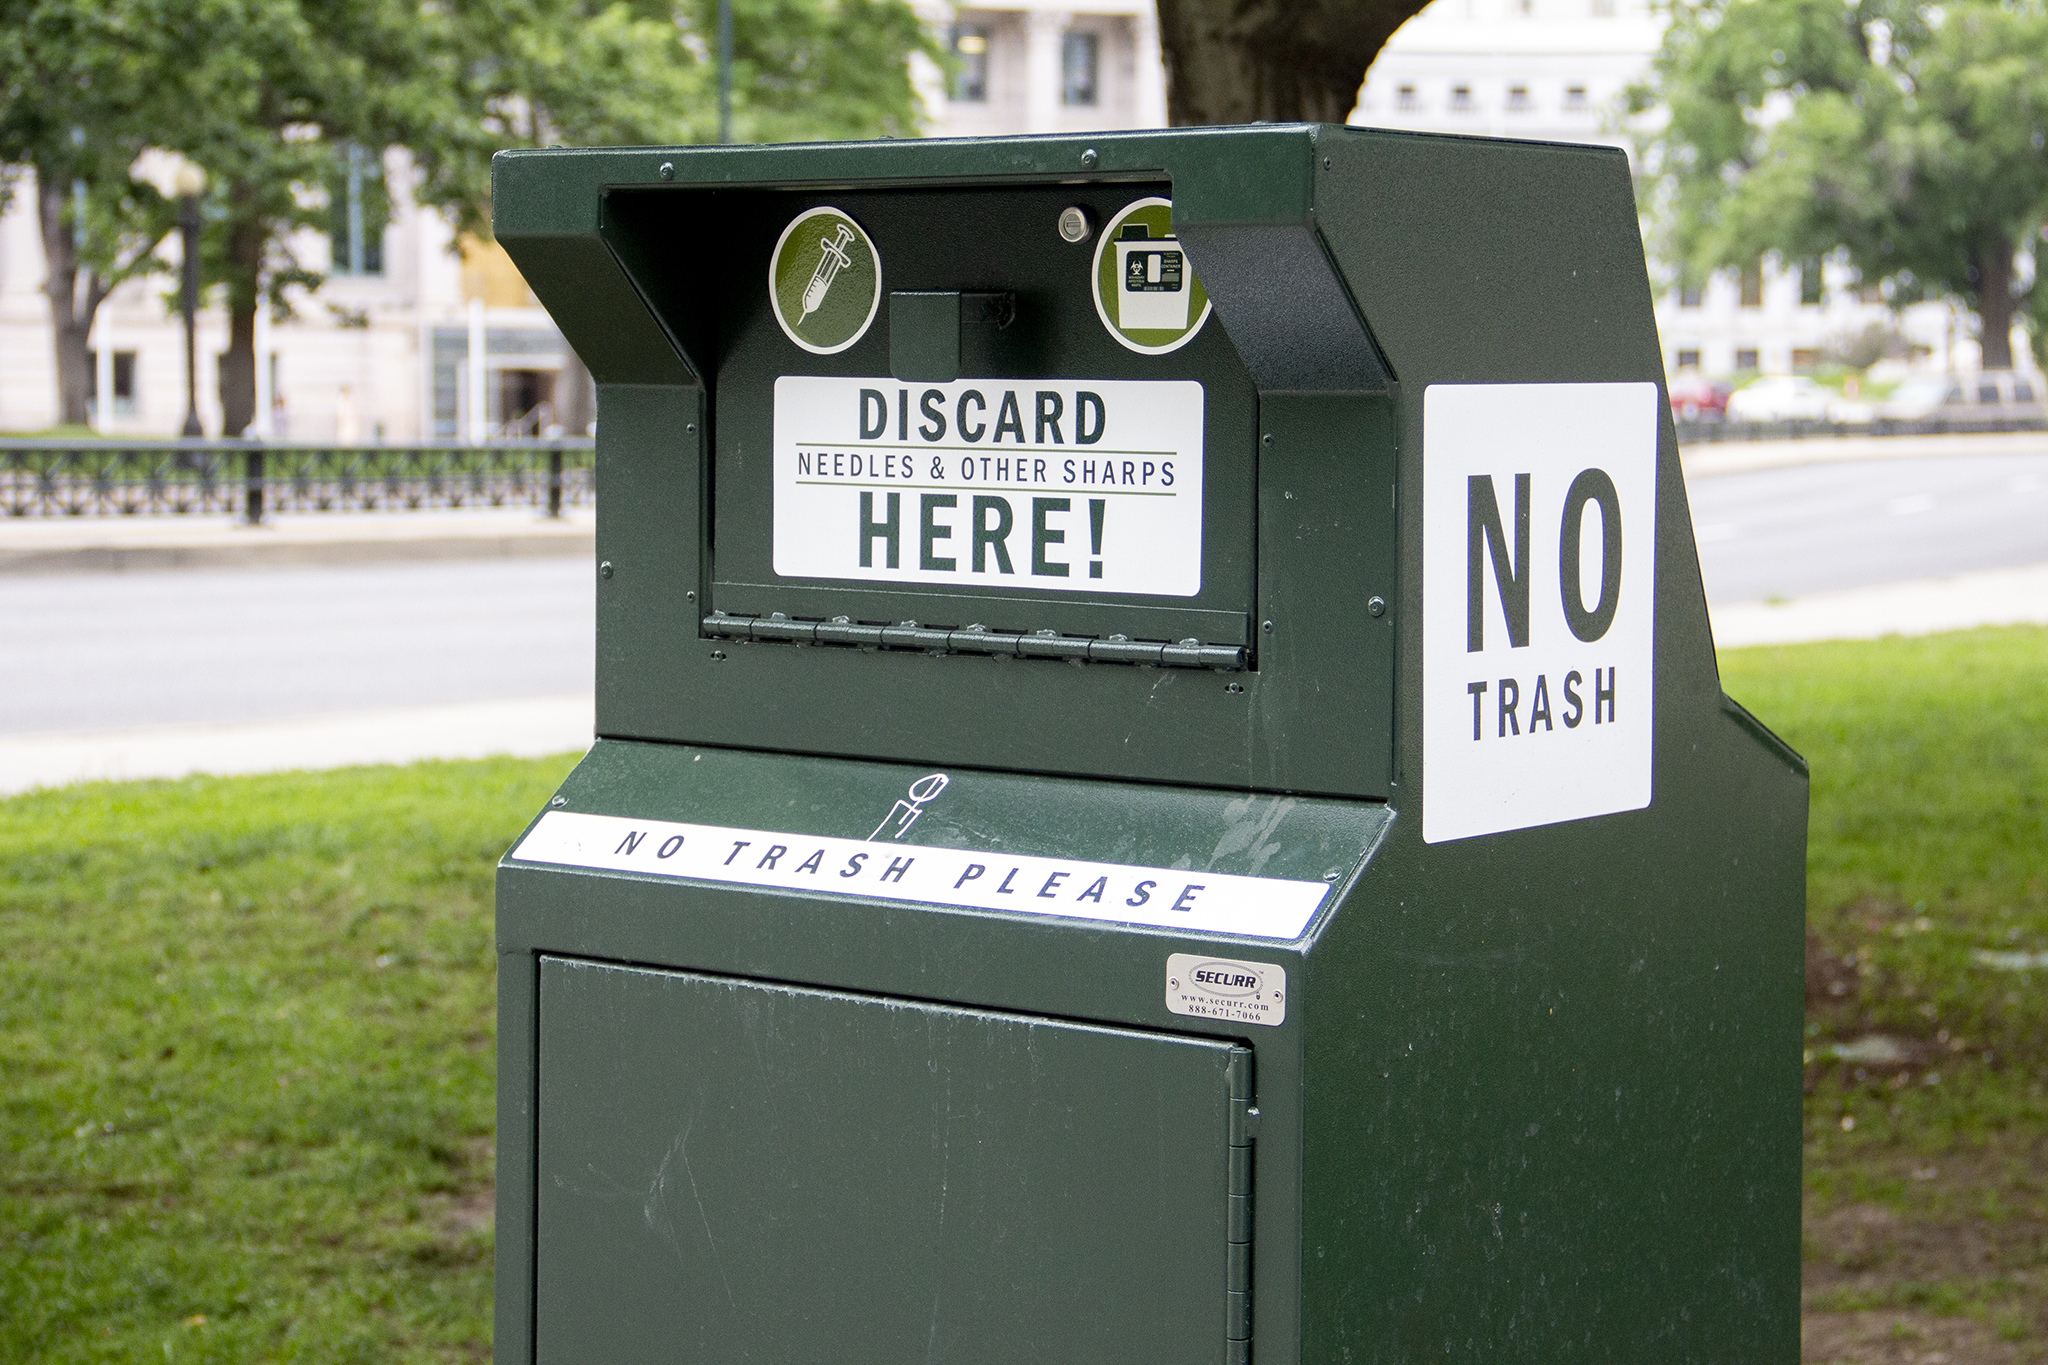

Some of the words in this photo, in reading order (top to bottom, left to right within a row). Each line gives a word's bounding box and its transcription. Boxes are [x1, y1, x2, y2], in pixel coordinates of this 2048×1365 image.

[859, 389, 1106, 444] DISCARD
[798, 453, 914, 479] NEEDLES
[930, 456, 945, 480] &
[961, 456, 1047, 483] OTHER
[1063, 459, 1175, 487] SHARPS
[859, 491, 1106, 579] HERE!
[1467, 467, 1623, 653] NO
[1467, 666, 1616, 741] TRASH
[614, 831, 685, 859] NO
[723, 841, 915, 883] TRASH
[953, 863, 1206, 912] PLEASE
[1181, 994, 1269, 1011] www.securr.com
[1195, 970, 1257, 989] SECURR
[1188, 1004, 1261, 1021] 888-671-7066
